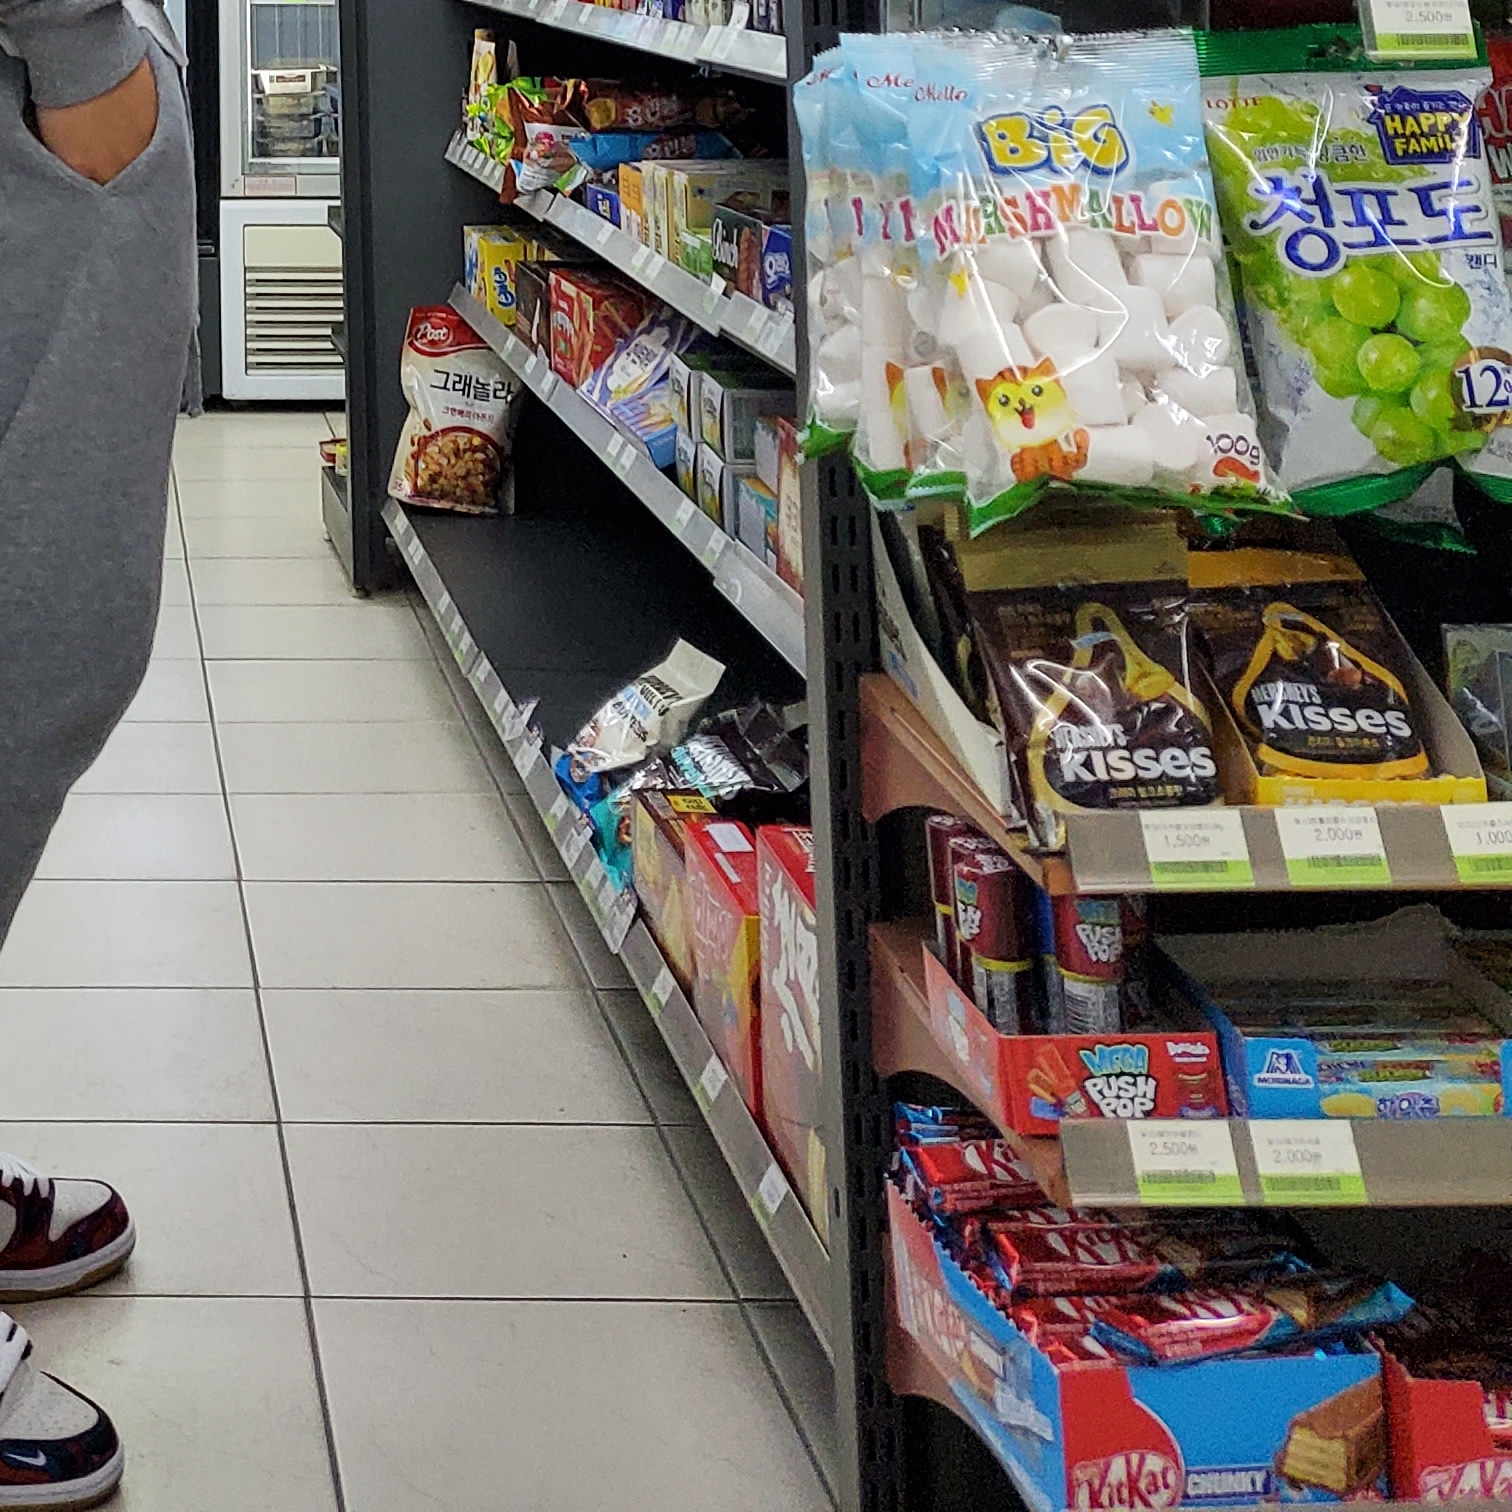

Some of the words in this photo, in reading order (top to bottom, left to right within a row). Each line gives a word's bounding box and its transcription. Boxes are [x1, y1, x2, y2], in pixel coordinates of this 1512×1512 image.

[1206, 97, 1263, 110] LOTTE
[932, 185, 1213, 258] MARSHMALLOW
[1249, 173, 1494, 272] 청포도
[416, 322, 448, 339] Post
[430, 369, 513, 404] 그래놀라
[1206, 431, 1260, 465] 100g
[1084, 1074, 1157, 1102] PUSH
[1100, 1095, 1156, 1118] POP
[1071, 1452, 1181, 1509] KitKat
[1187, 1470, 1270, 1497] CHUNKY
